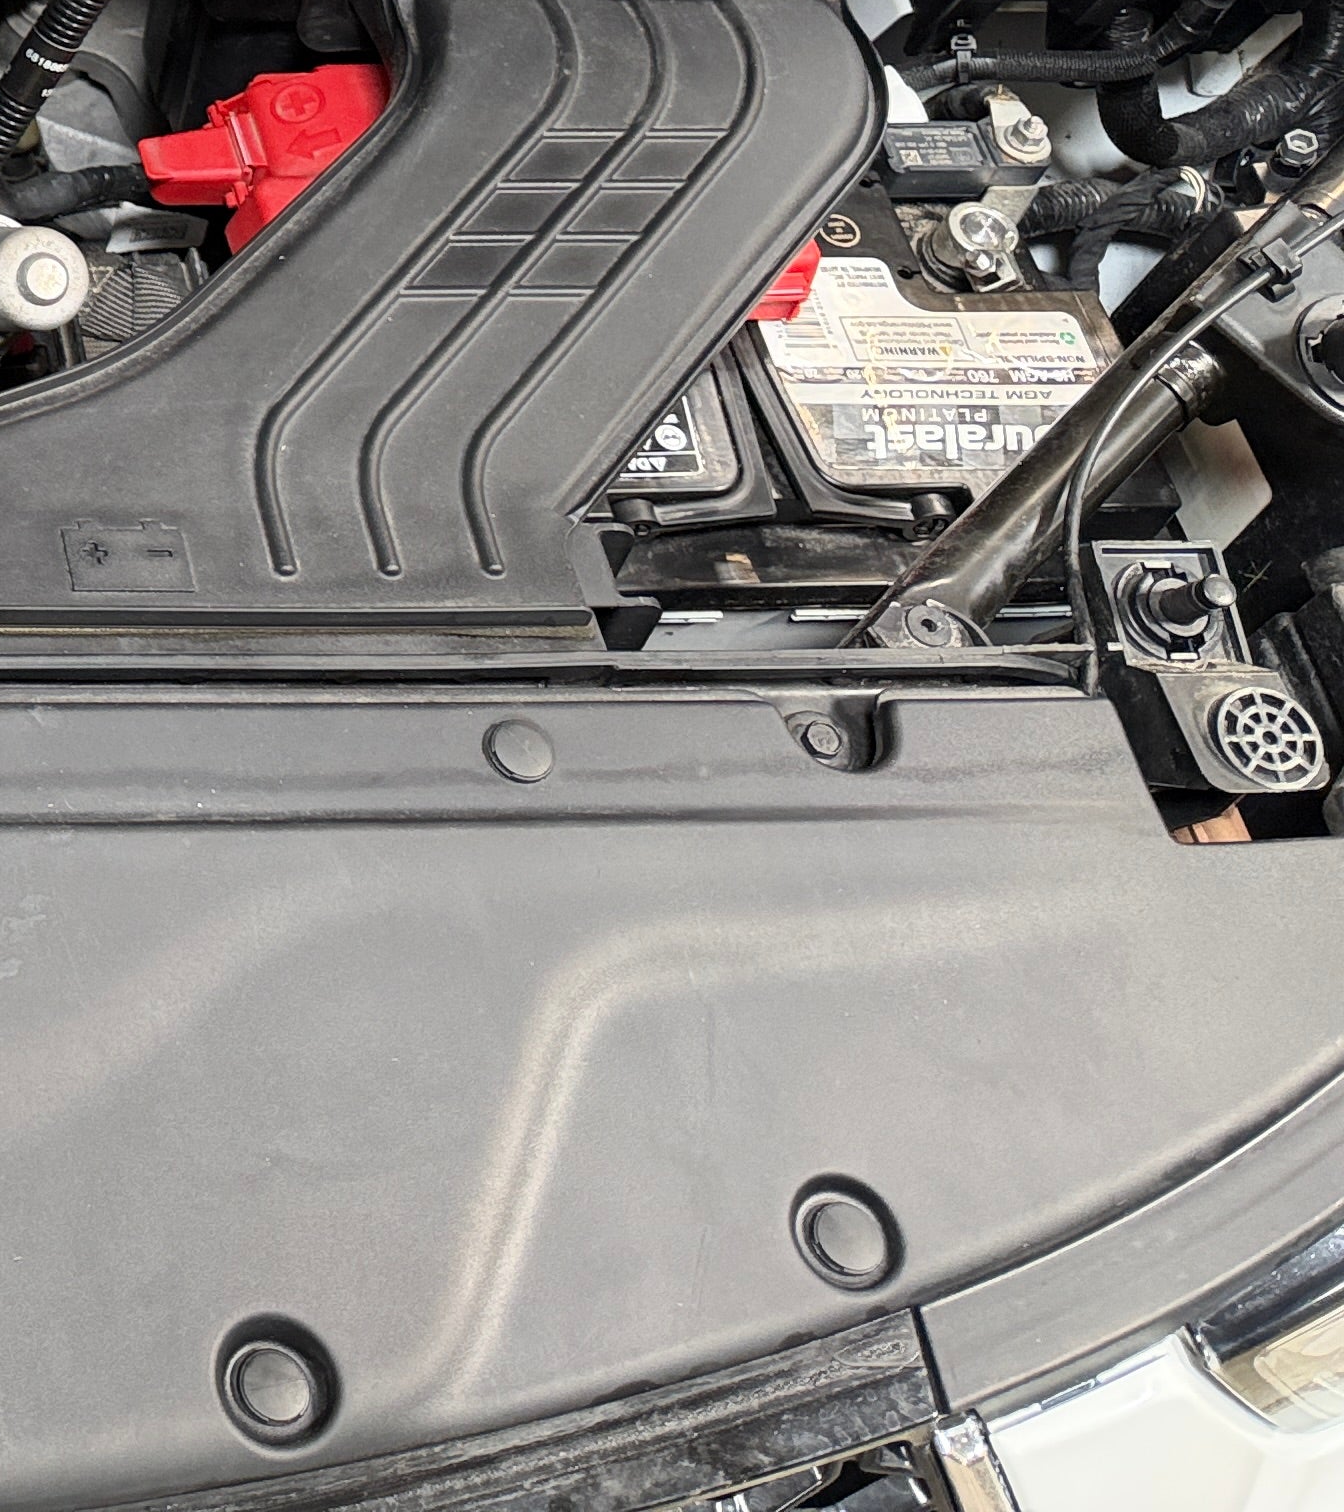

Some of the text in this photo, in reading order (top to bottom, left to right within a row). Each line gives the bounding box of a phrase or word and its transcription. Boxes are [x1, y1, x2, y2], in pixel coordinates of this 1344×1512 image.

[967, 369, 999, 383] 760
[1006, 389, 1053, 399] AGM
[862, 408, 987, 423] PLATINUM
[867, 424, 1055, 460] uralast
